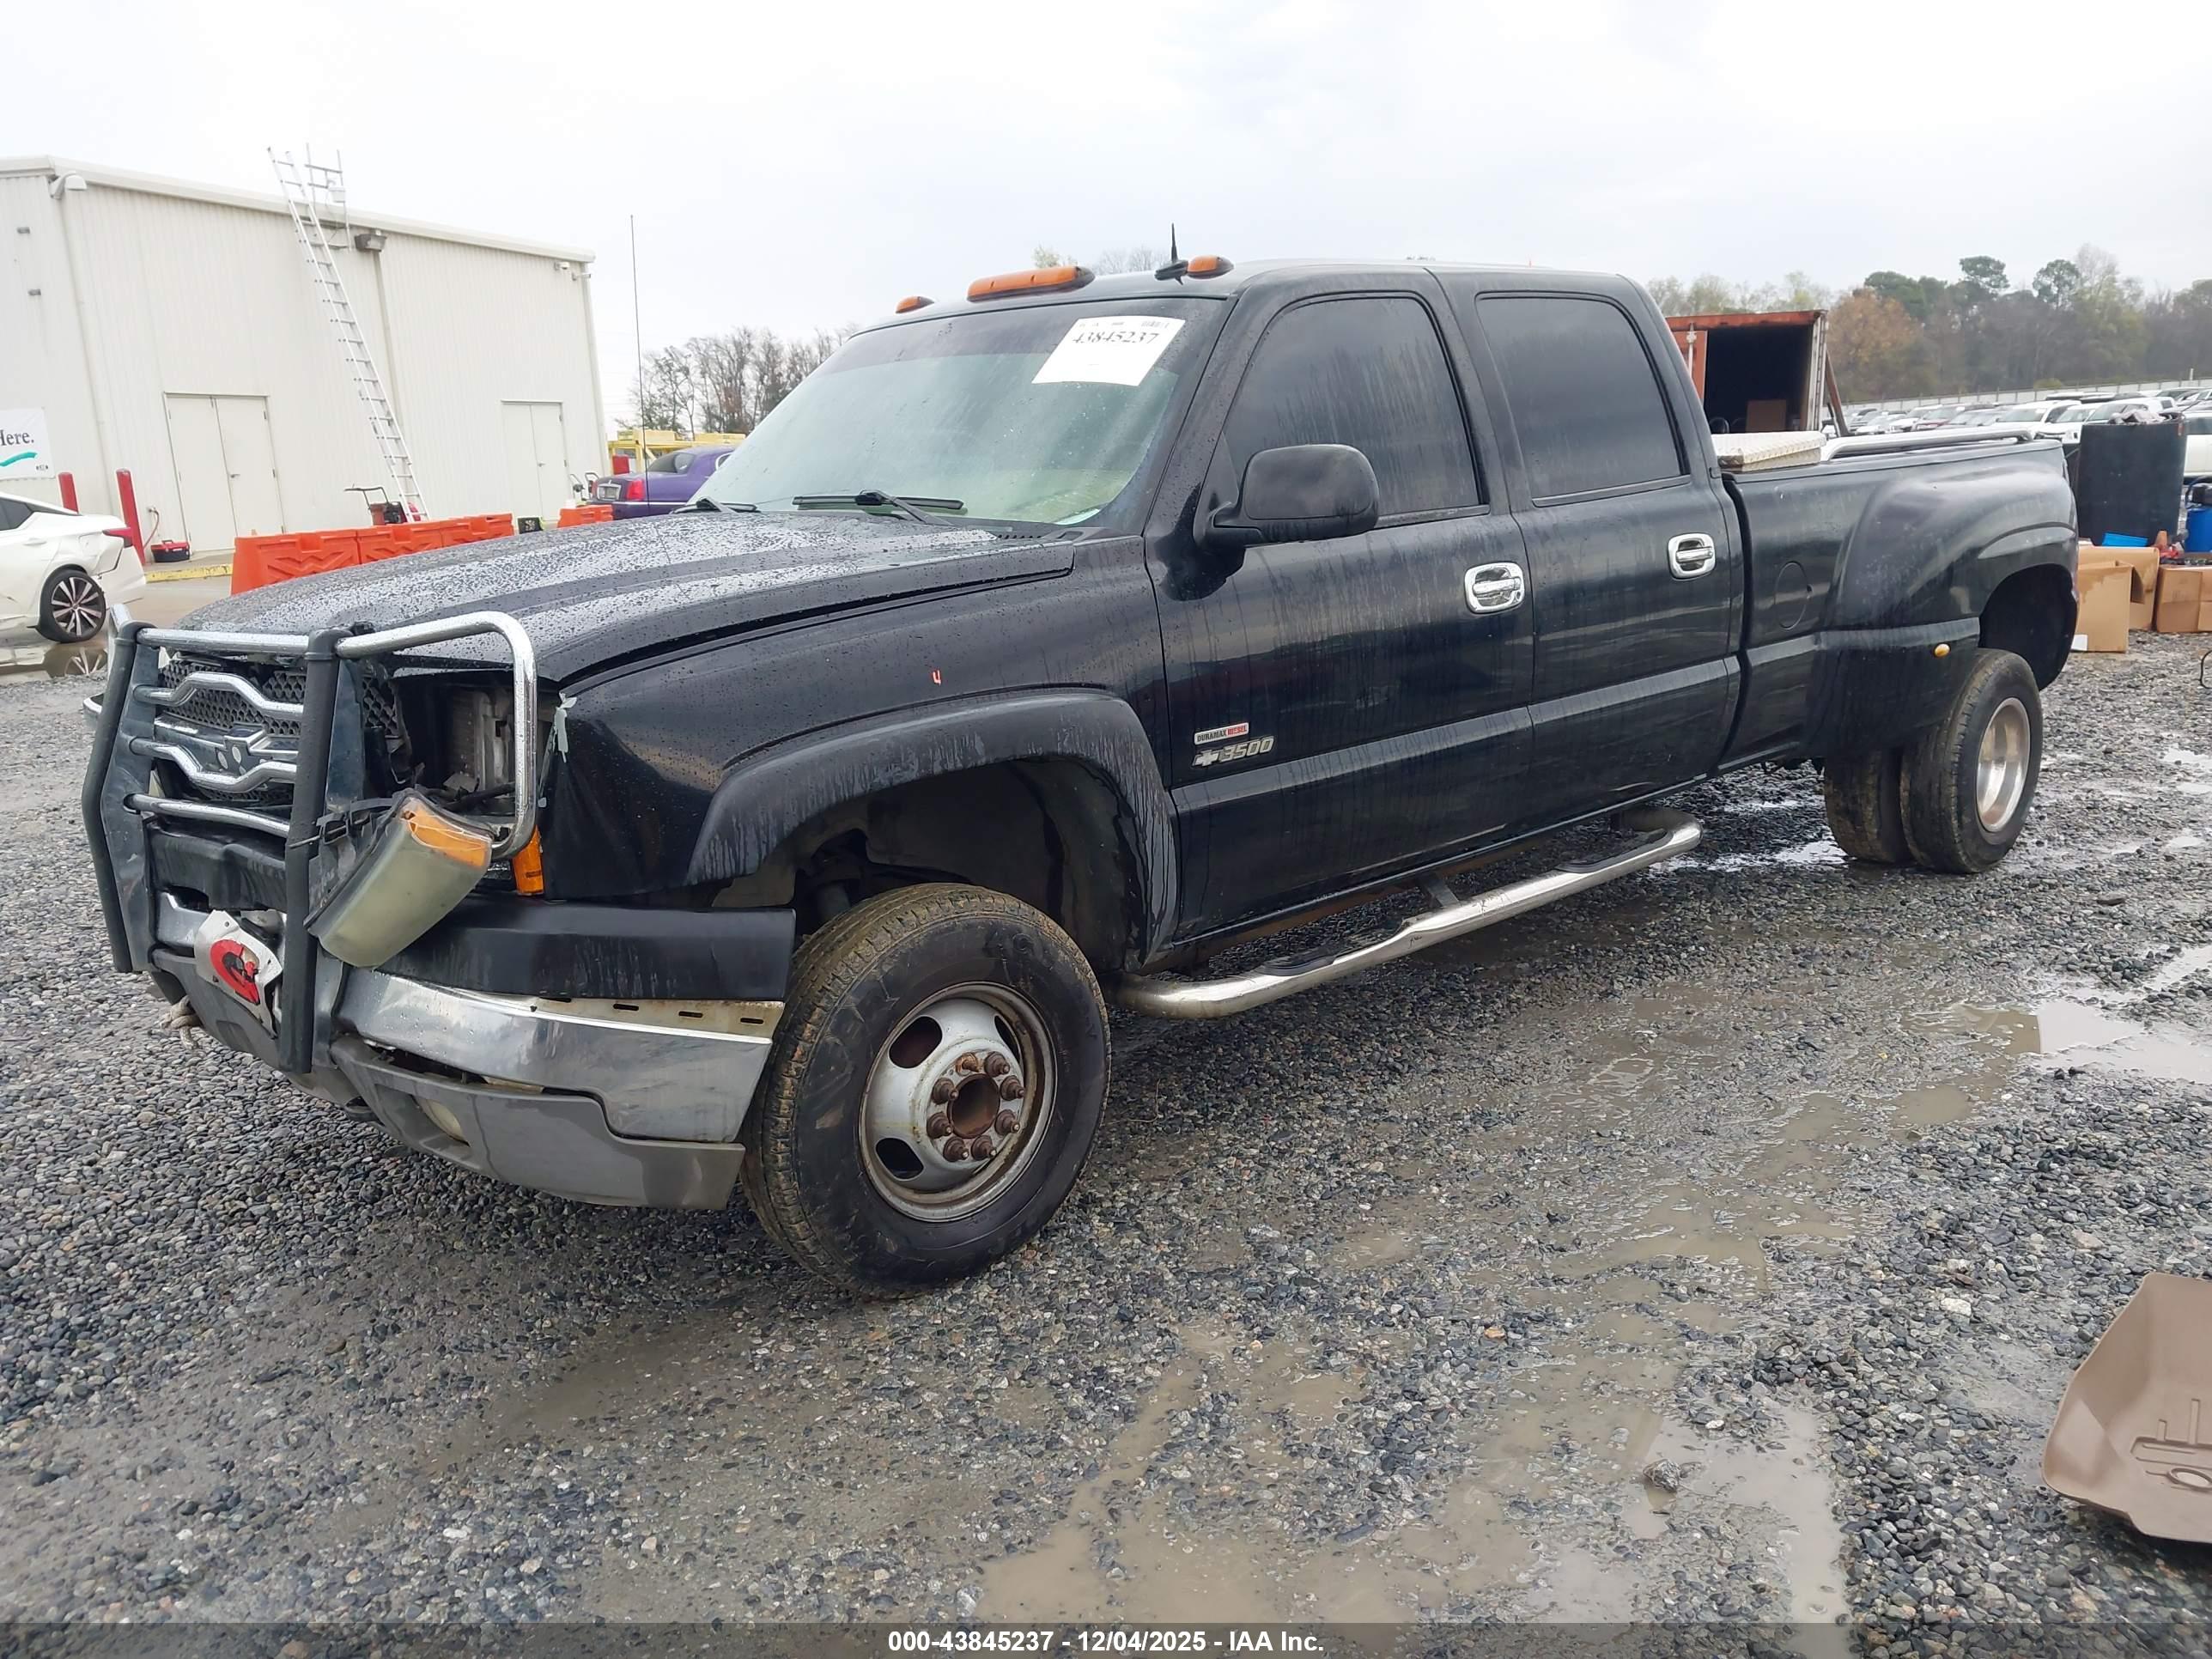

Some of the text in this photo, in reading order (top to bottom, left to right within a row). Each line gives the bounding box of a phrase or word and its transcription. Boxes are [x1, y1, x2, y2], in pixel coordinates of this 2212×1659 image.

[1073, 331, 1160, 344] 43845237
[1196, 725, 1248, 743] DURAMAX DIESEL
[1218, 736, 1274, 763] 3500
